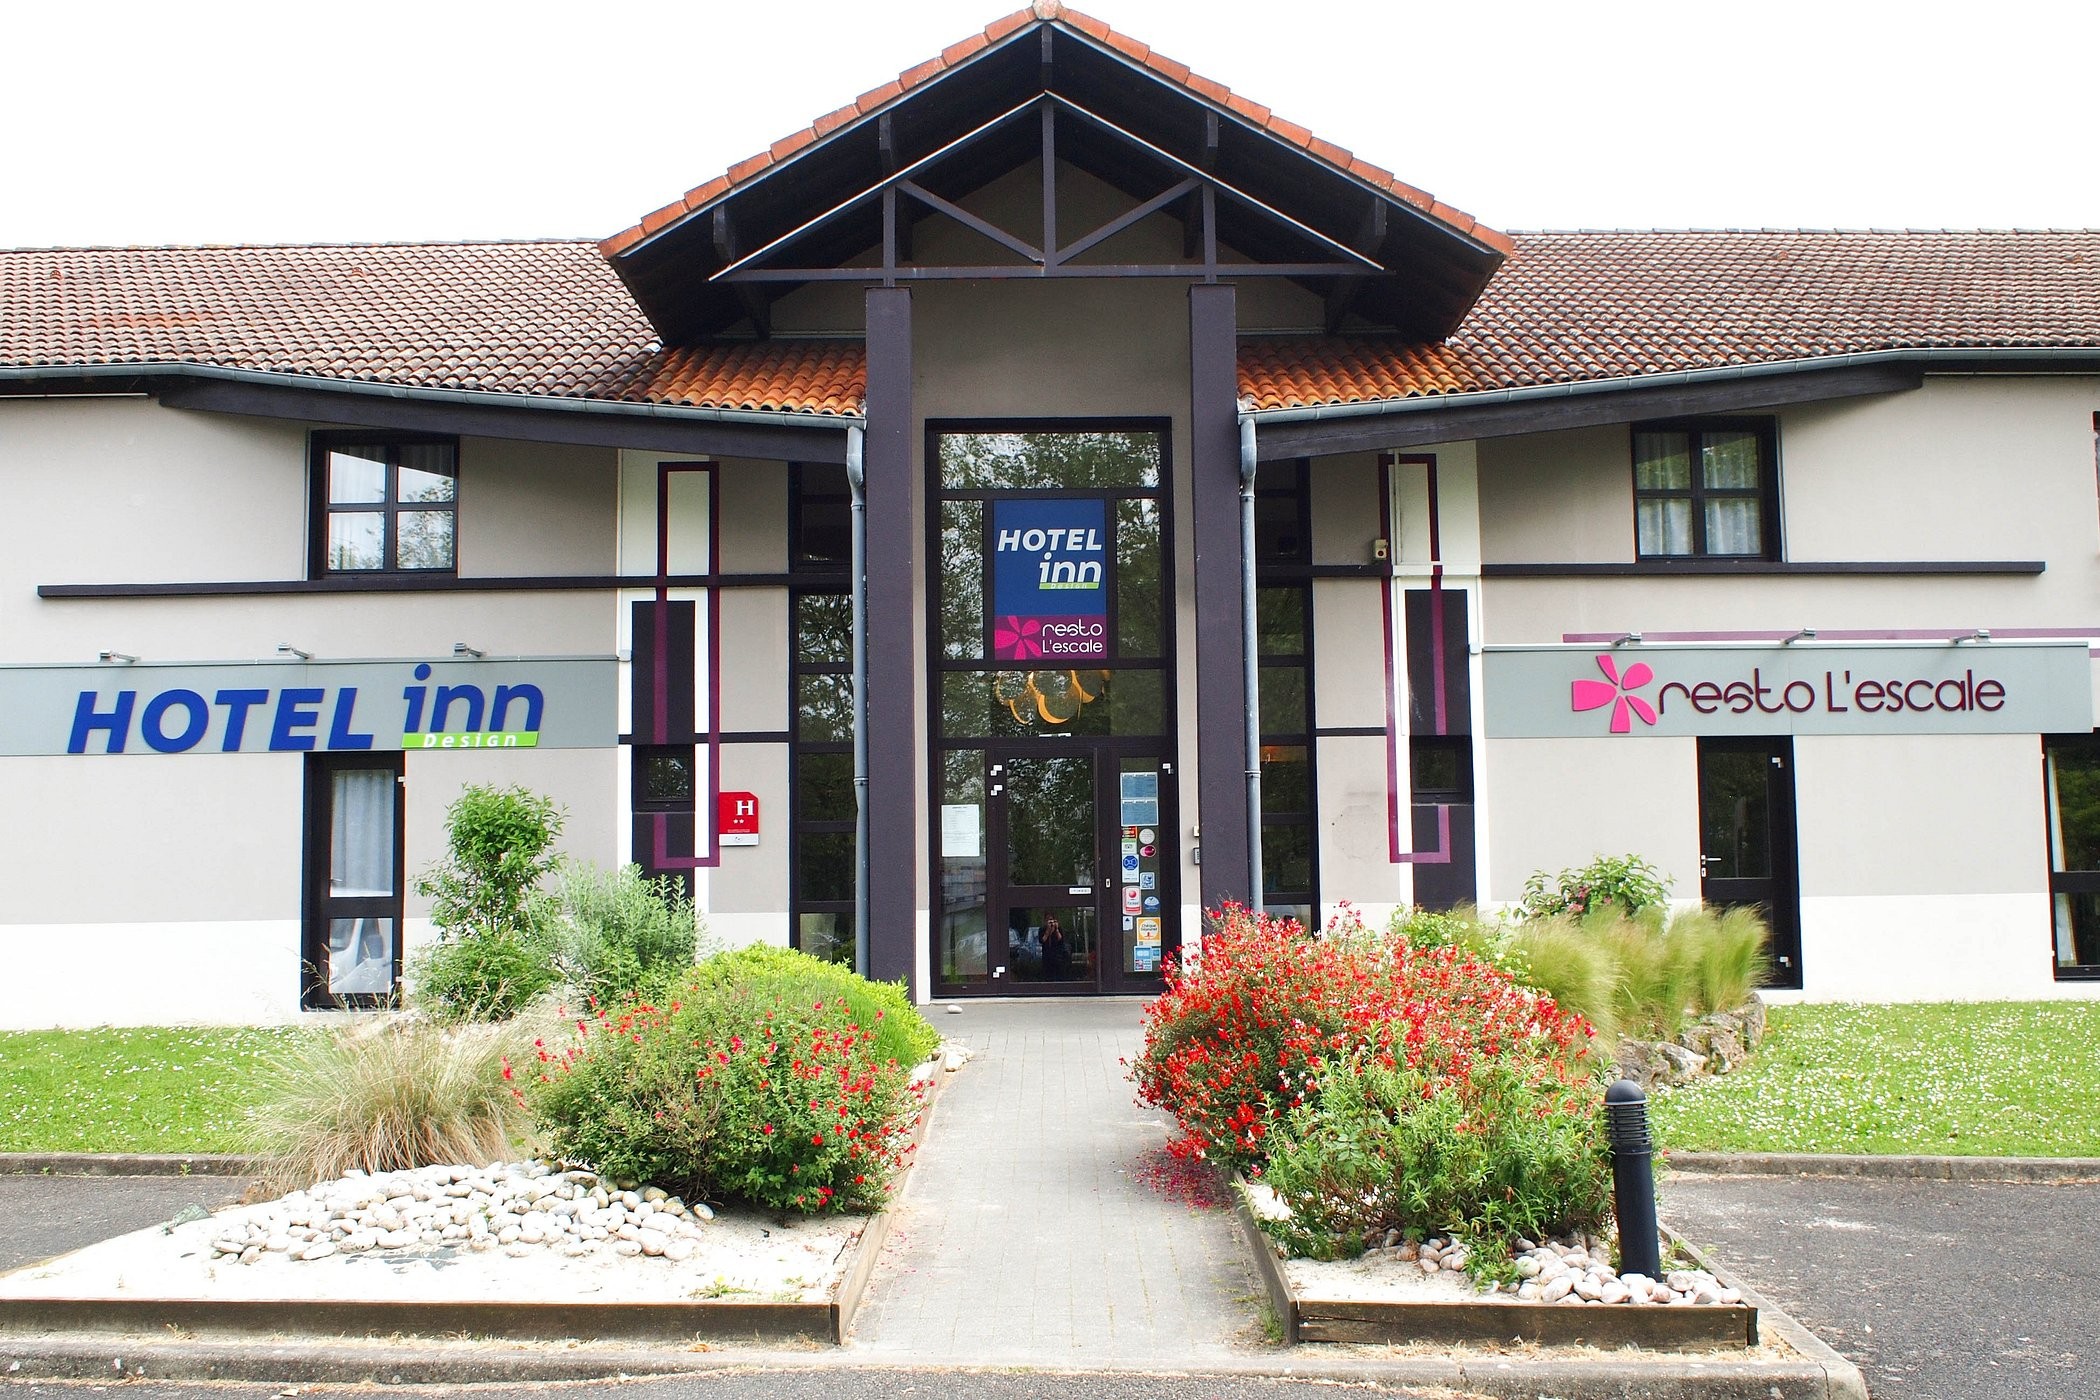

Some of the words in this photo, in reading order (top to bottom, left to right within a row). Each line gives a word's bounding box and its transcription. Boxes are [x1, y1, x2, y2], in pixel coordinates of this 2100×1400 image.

[997, 527, 1103, 552] HOTEL
[1039, 551, 1102, 583] inn
[1042, 618, 1103, 637] resto
[1042, 638, 1103, 653] L'escale
[1658, 667, 1816, 715] resto
[1826, 669, 2006, 713] L'escale
[66, 686, 373, 754] HOTEL
[402, 662, 545, 733] inn
[423, 732, 518, 748] Design
[735, 799, 755, 816] H
